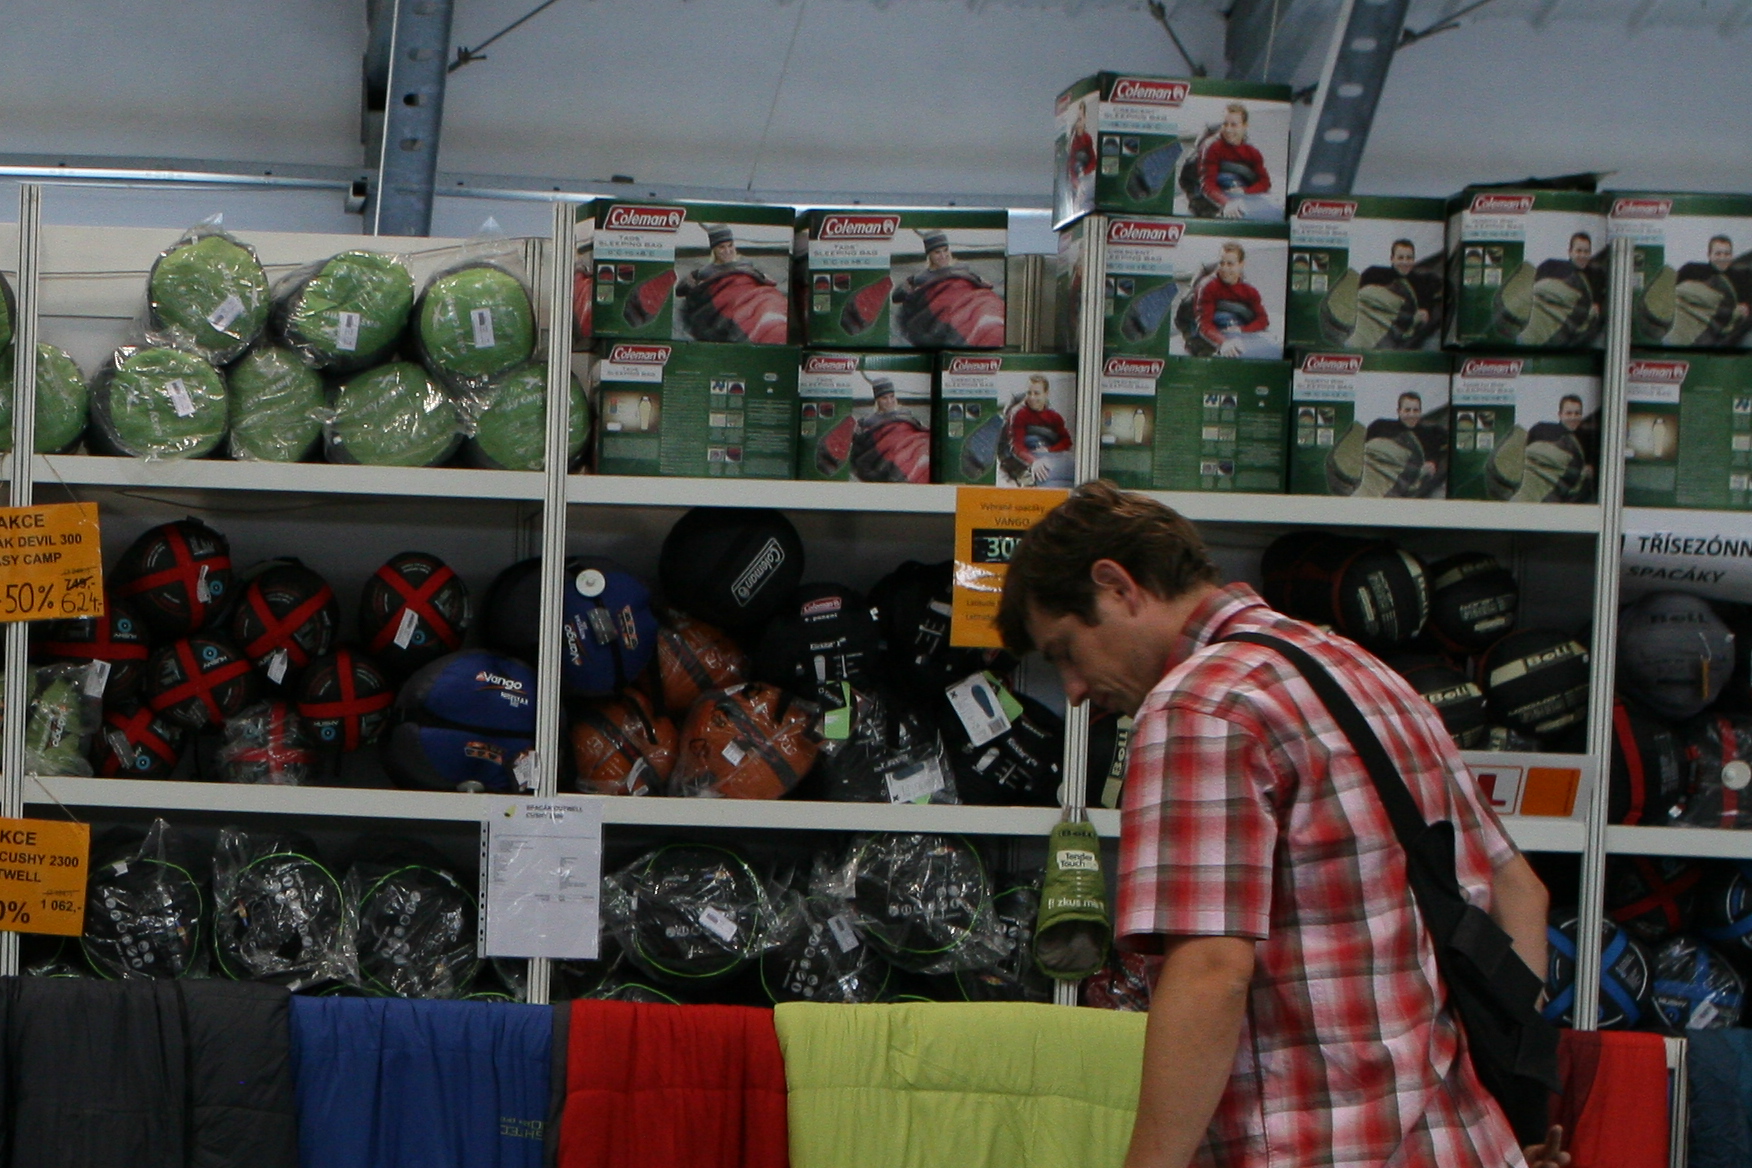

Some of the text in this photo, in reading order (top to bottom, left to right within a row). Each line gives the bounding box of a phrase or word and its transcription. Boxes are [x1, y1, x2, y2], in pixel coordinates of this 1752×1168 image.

[1117, 79, 1171, 99] Coleman
[1303, 200, 1345, 218] Coleman
[611, 208, 667, 228] Coleman
[826, 218, 881, 235] Coleman
[1110, 222, 1167, 240] Coleman
[614, 348, 657, 361] Coleman
[1307, 354, 1349, 370] Coleman
[808, 357, 846, 371] Coleman
[952, 358, 990, 371] Coleman
[1108, 361, 1150, 374] Coleman
[1468, 359, 1511, 375] Coleman
[995, 517, 1030, 527] VANGO
[18, 535, 56, 547] DEVIL
[60, 534, 82, 546] 300
[23, 552, 62, 565] CAMP
[744, 548, 782, 589] Coleman
[1627, 566, 1726, 584] SPACÁKY
[1527, 645, 1571, 668] Boll
[483, 671, 523, 691] Vango
[1111, 731, 1128, 777] Boll
[49, 855, 79, 868] 2300
[1061, 859, 1085, 868] Touch
[1066, 852, 1093, 862] Tender
[1058, 897, 1081, 907] zkus
